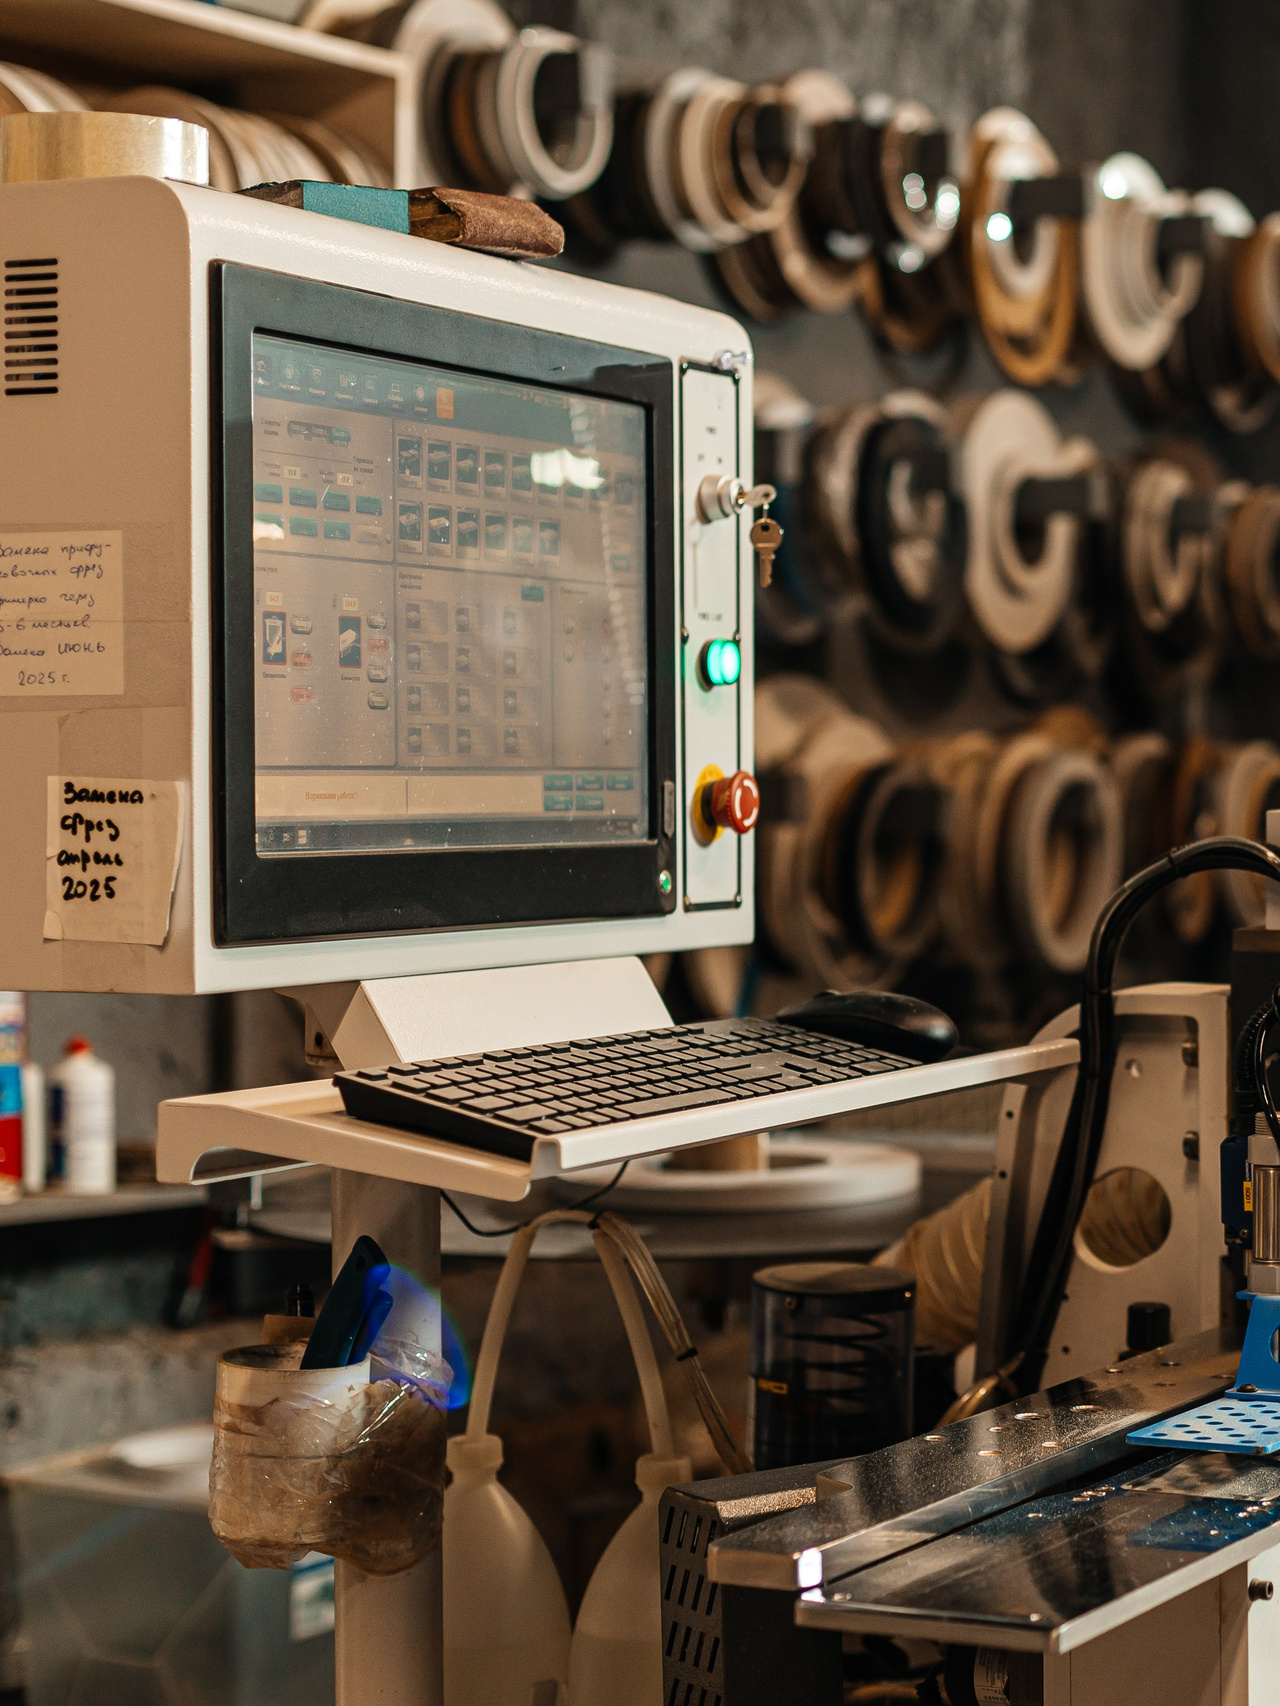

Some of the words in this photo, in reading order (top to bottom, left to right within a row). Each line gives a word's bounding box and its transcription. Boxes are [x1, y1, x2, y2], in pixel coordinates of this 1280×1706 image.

[18, 670, 56, 686] 2025
[63, 781, 144, 805] Замена
[57, 849, 124, 873] апрель
[62, 875, 117, 902] 2025
